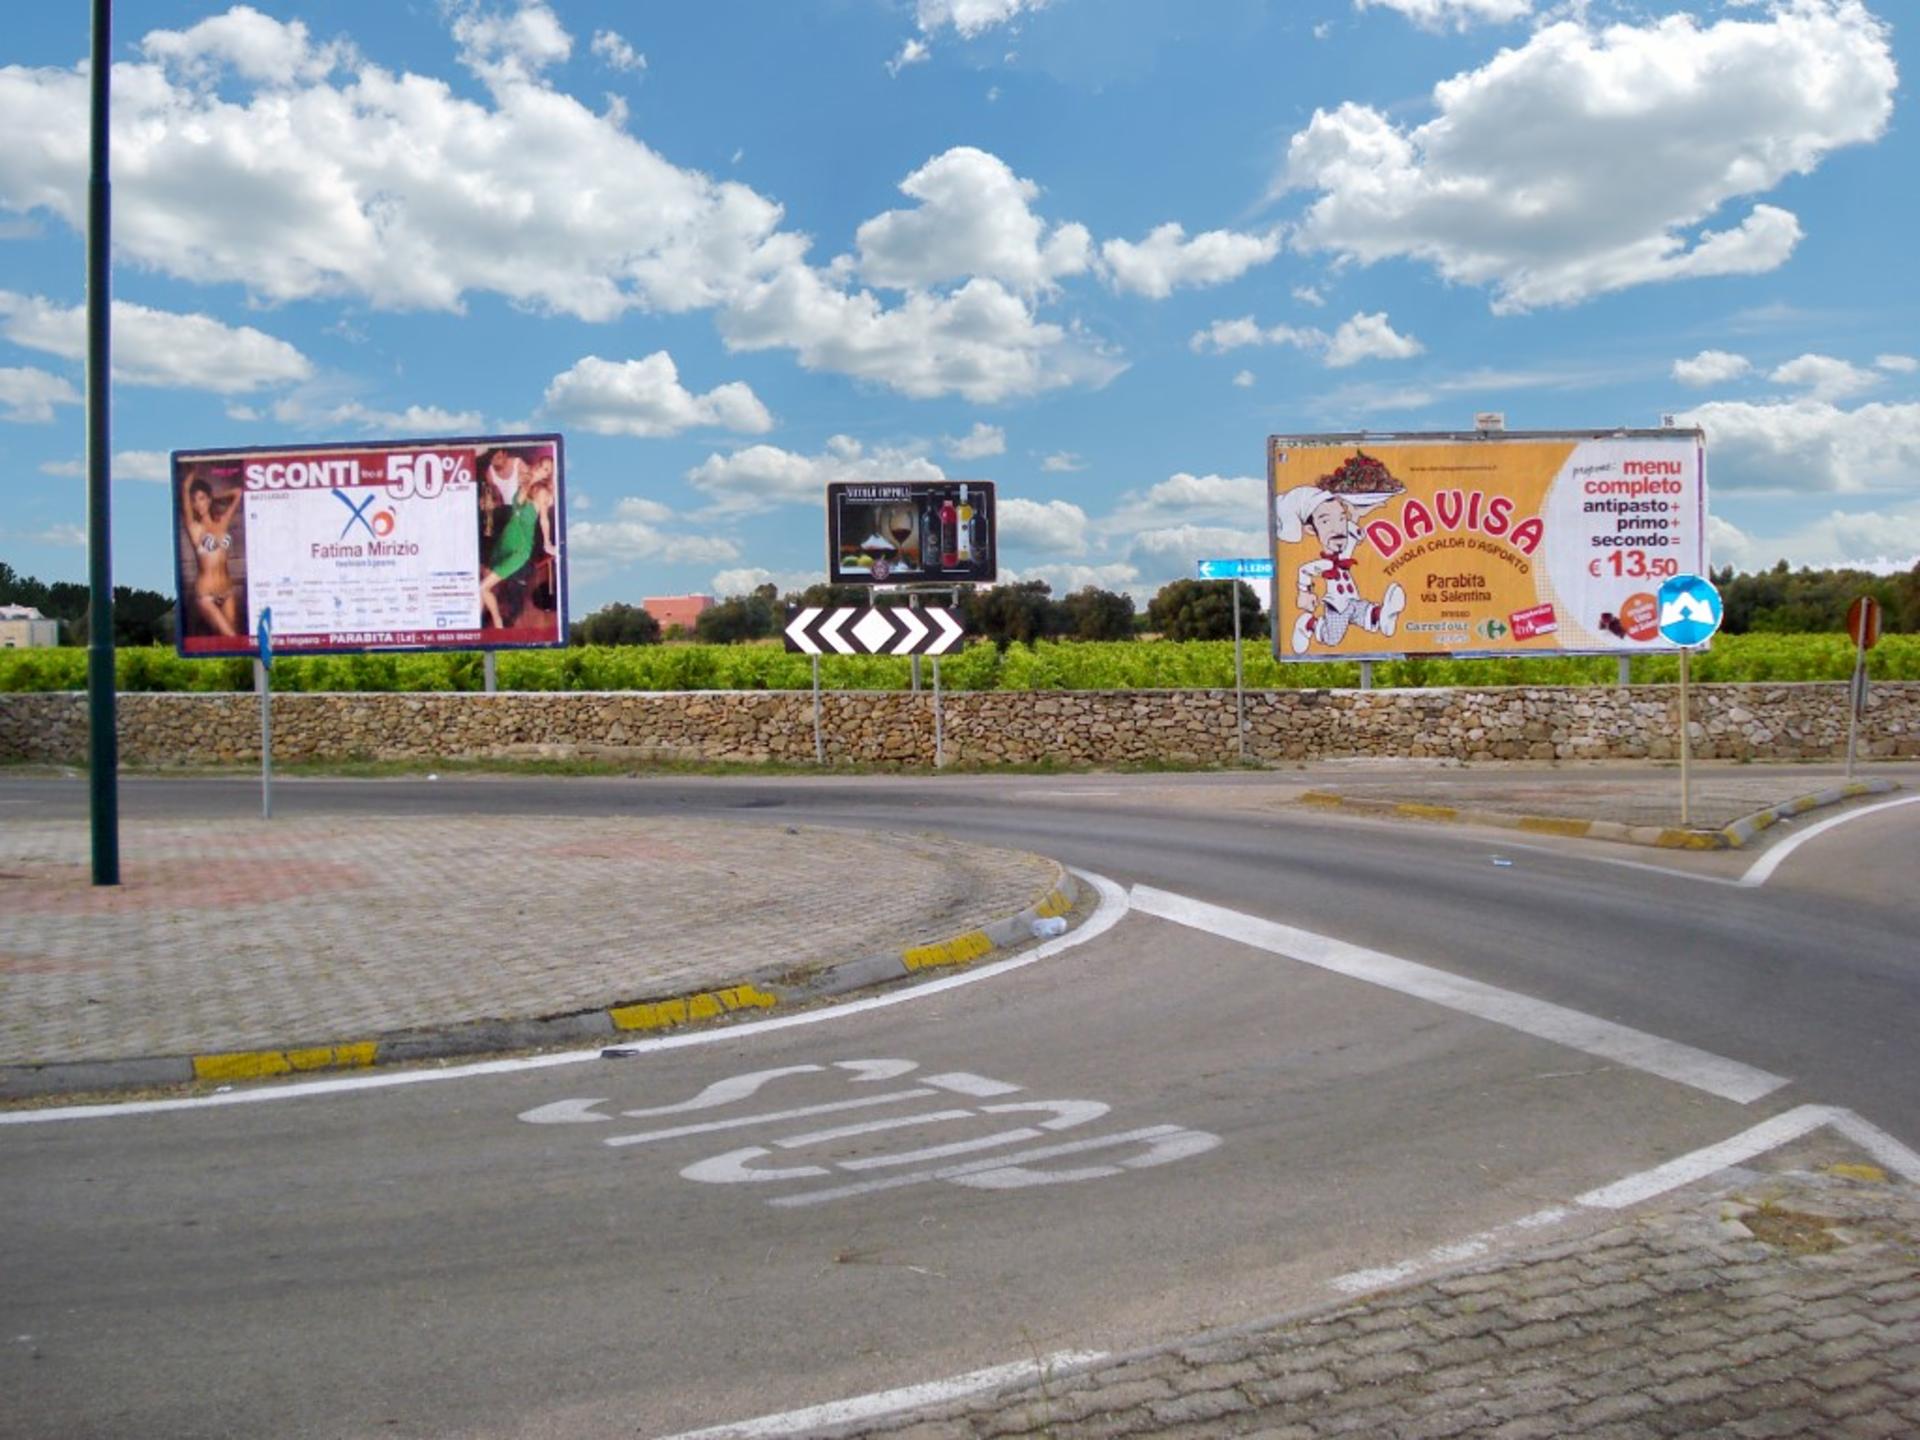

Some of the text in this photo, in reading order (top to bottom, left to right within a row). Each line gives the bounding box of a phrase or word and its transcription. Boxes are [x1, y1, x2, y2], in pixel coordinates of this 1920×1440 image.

[1623, 460, 1682, 475] menu
[246, 461, 359, 490] SCONTI
[386, 453, 471, 500] 50%
[1584, 478, 1682, 498] completo
[1583, 499, 1669, 515] antipasto
[1366, 489, 1545, 559] DAVISA
[1617, 516, 1669, 532] primo
[1591, 533, 1669, 547] secondo
[311, 540, 420, 558] Fatima Mirizio
[1426, 573, 1486, 589] Parabita
[1441, 590, 1492, 602] Salentina
[330, 633, 394, 644] PARABITA
